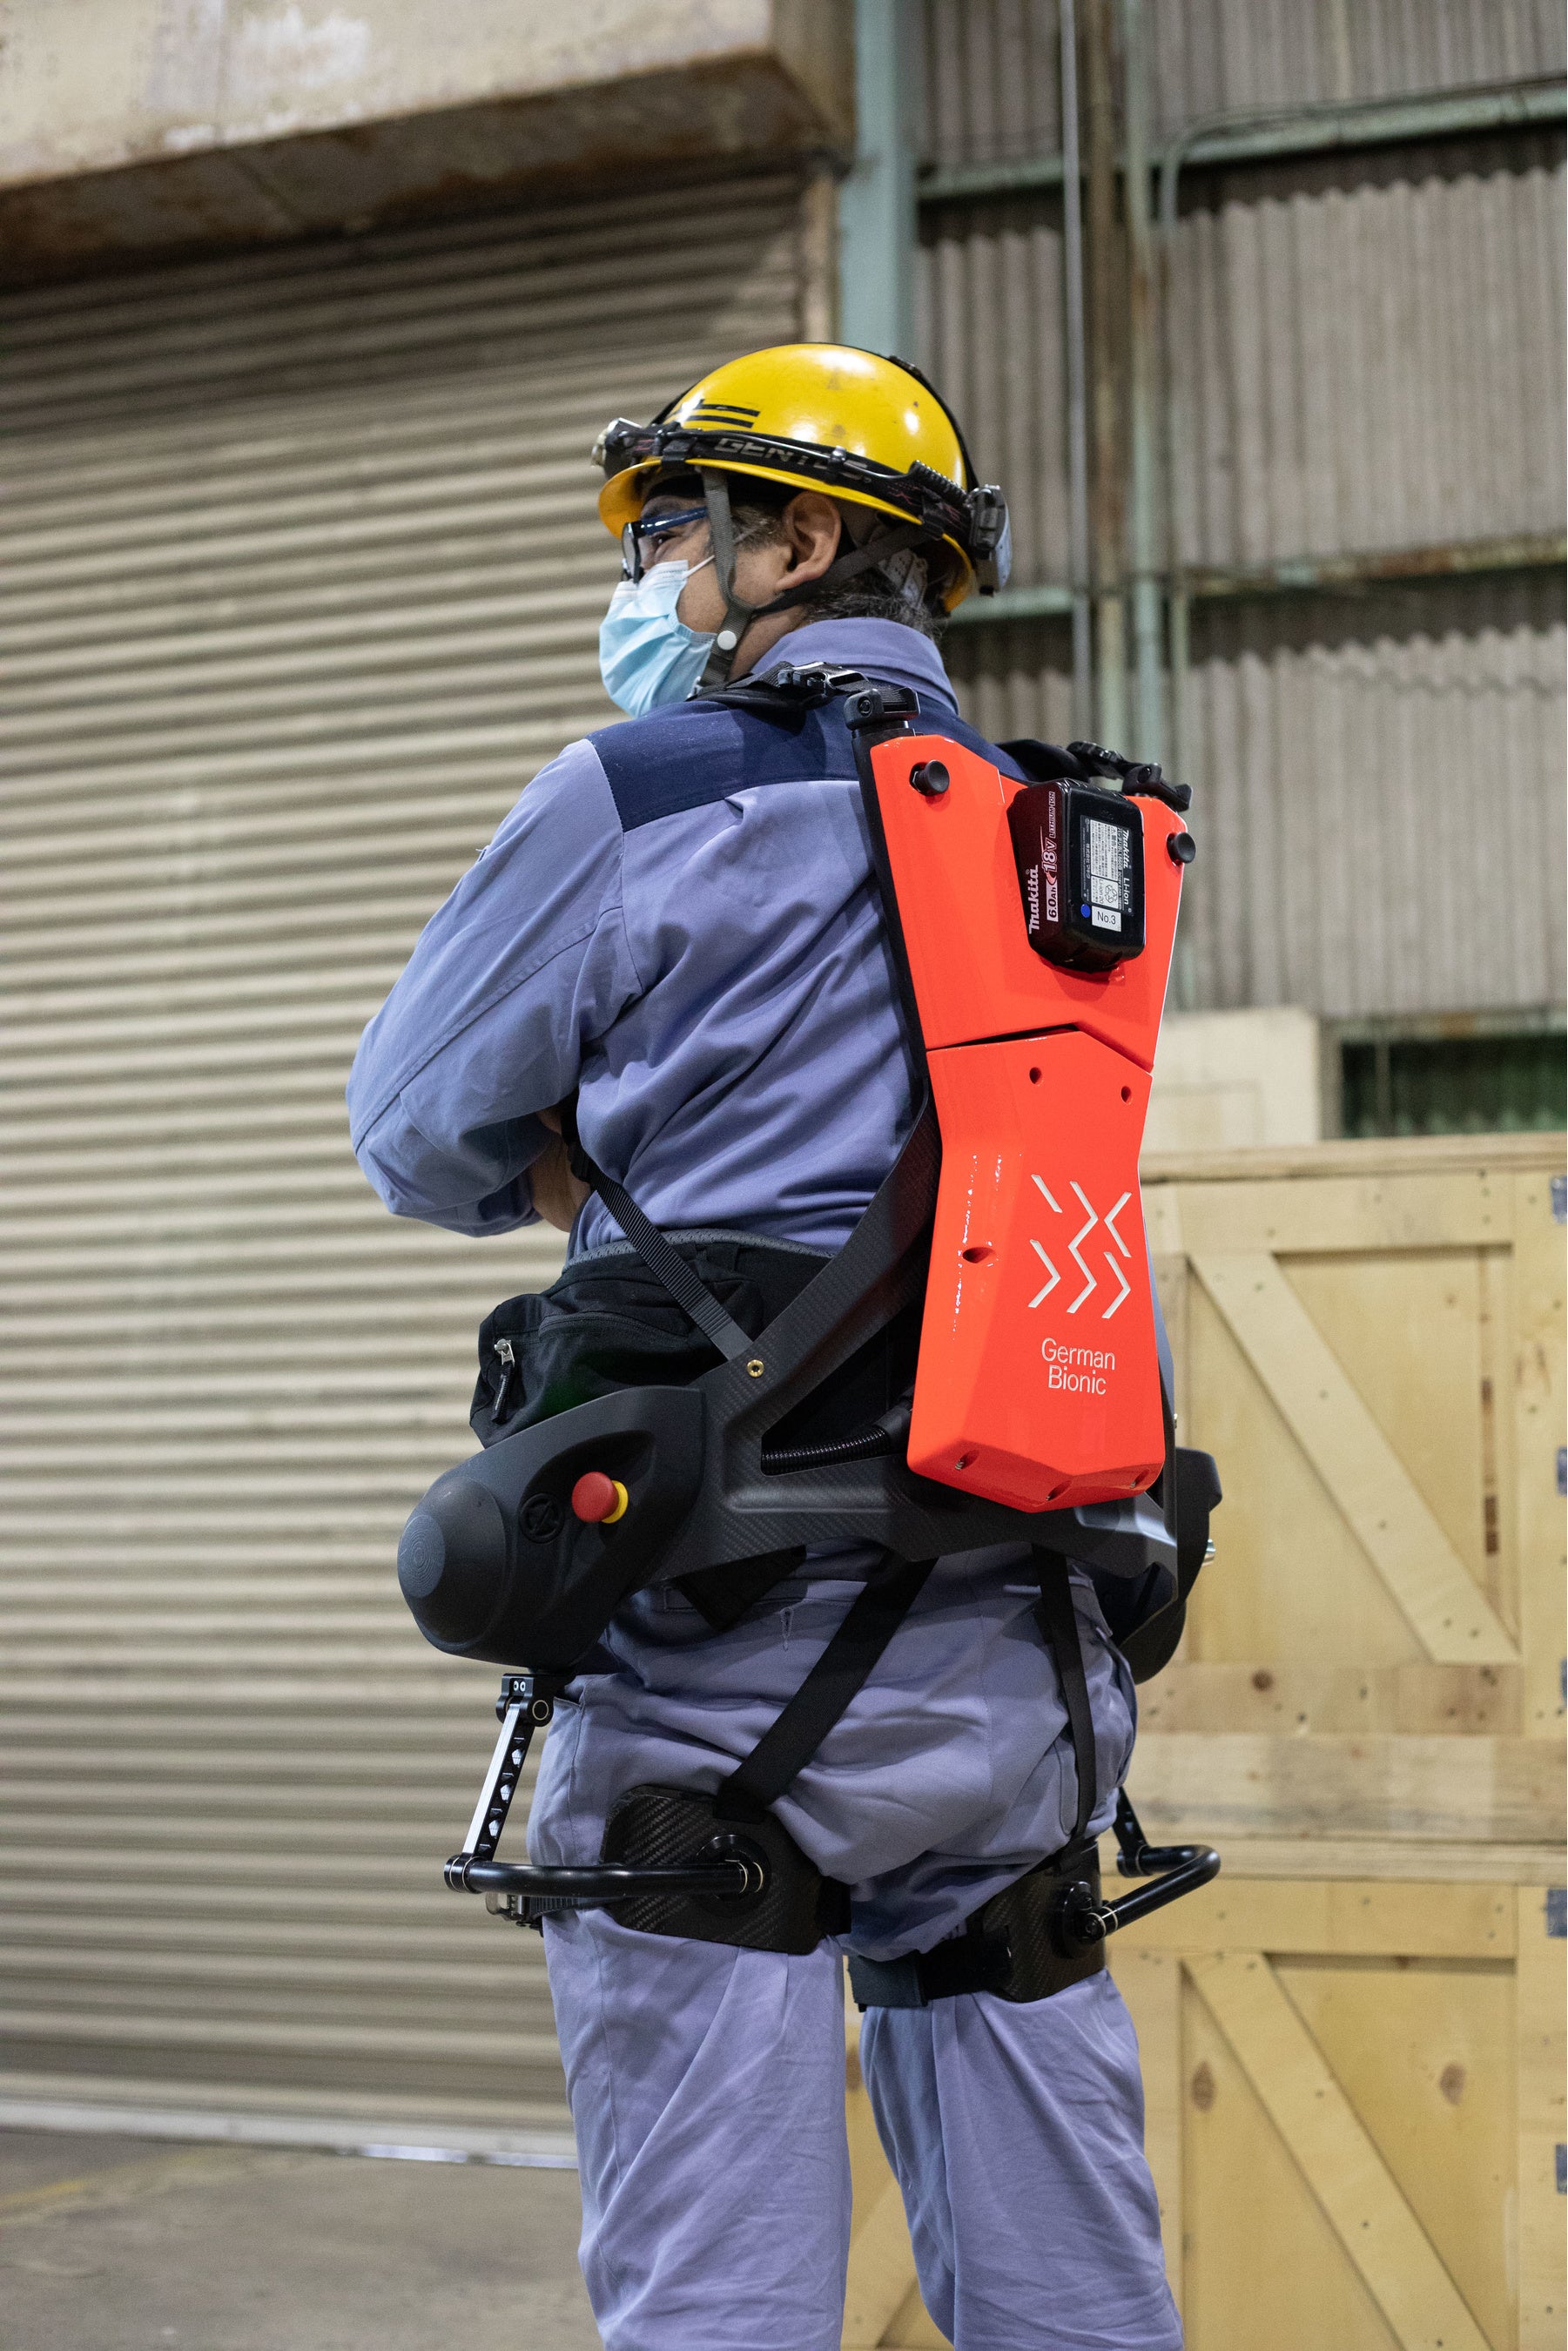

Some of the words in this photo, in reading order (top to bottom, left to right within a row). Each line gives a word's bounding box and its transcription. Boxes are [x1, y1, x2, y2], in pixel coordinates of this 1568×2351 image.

[1042, 838, 1057, 872] 18V
[1048, 886, 1057, 918] 6.0Ah
[1097, 911, 1116, 925] No.3
[1041, 1337, 1116, 1371] German
[1048, 1365, 1107, 1395] Bionic
